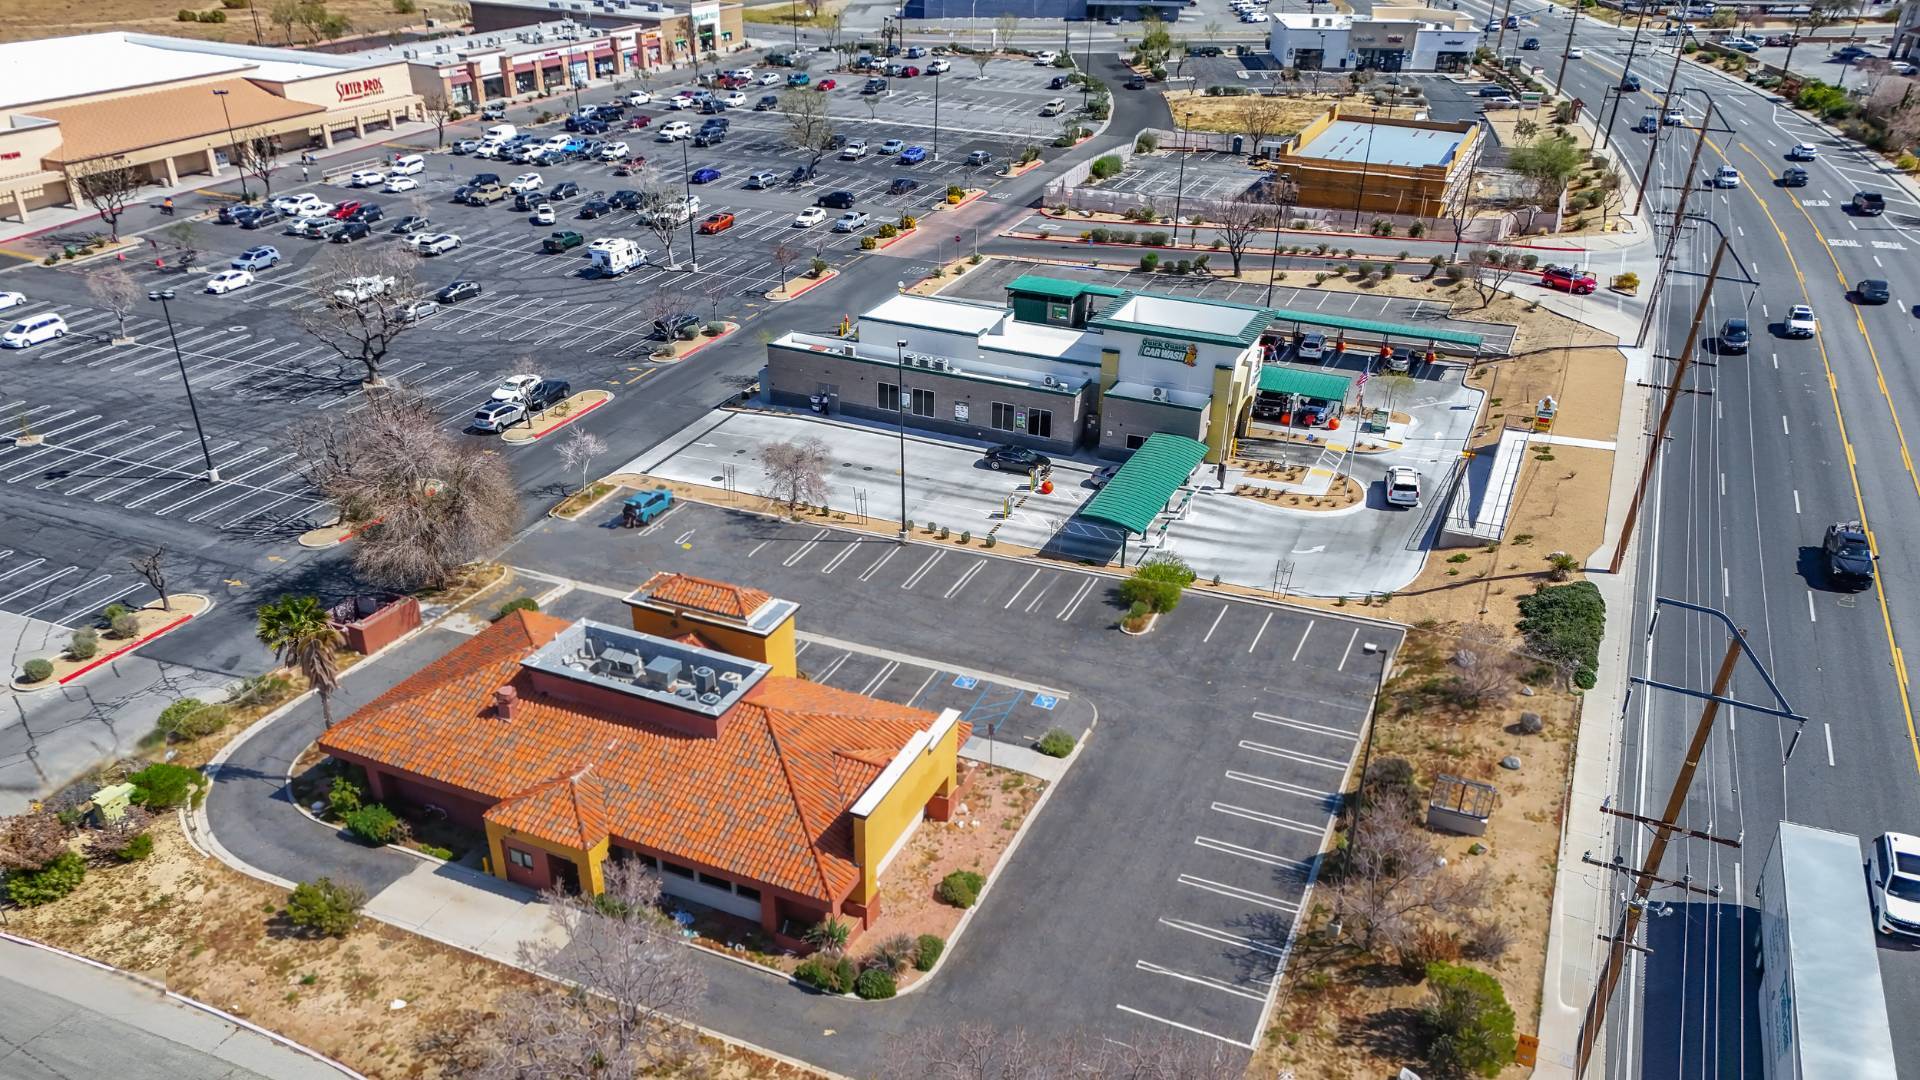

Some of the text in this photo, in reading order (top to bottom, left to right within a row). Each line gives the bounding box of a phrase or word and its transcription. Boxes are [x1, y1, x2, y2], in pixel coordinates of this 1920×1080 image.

[1827, 239, 1907, 250] SIGNAL SIGNAL
[1143, 347, 1186, 361] CAR WASH
